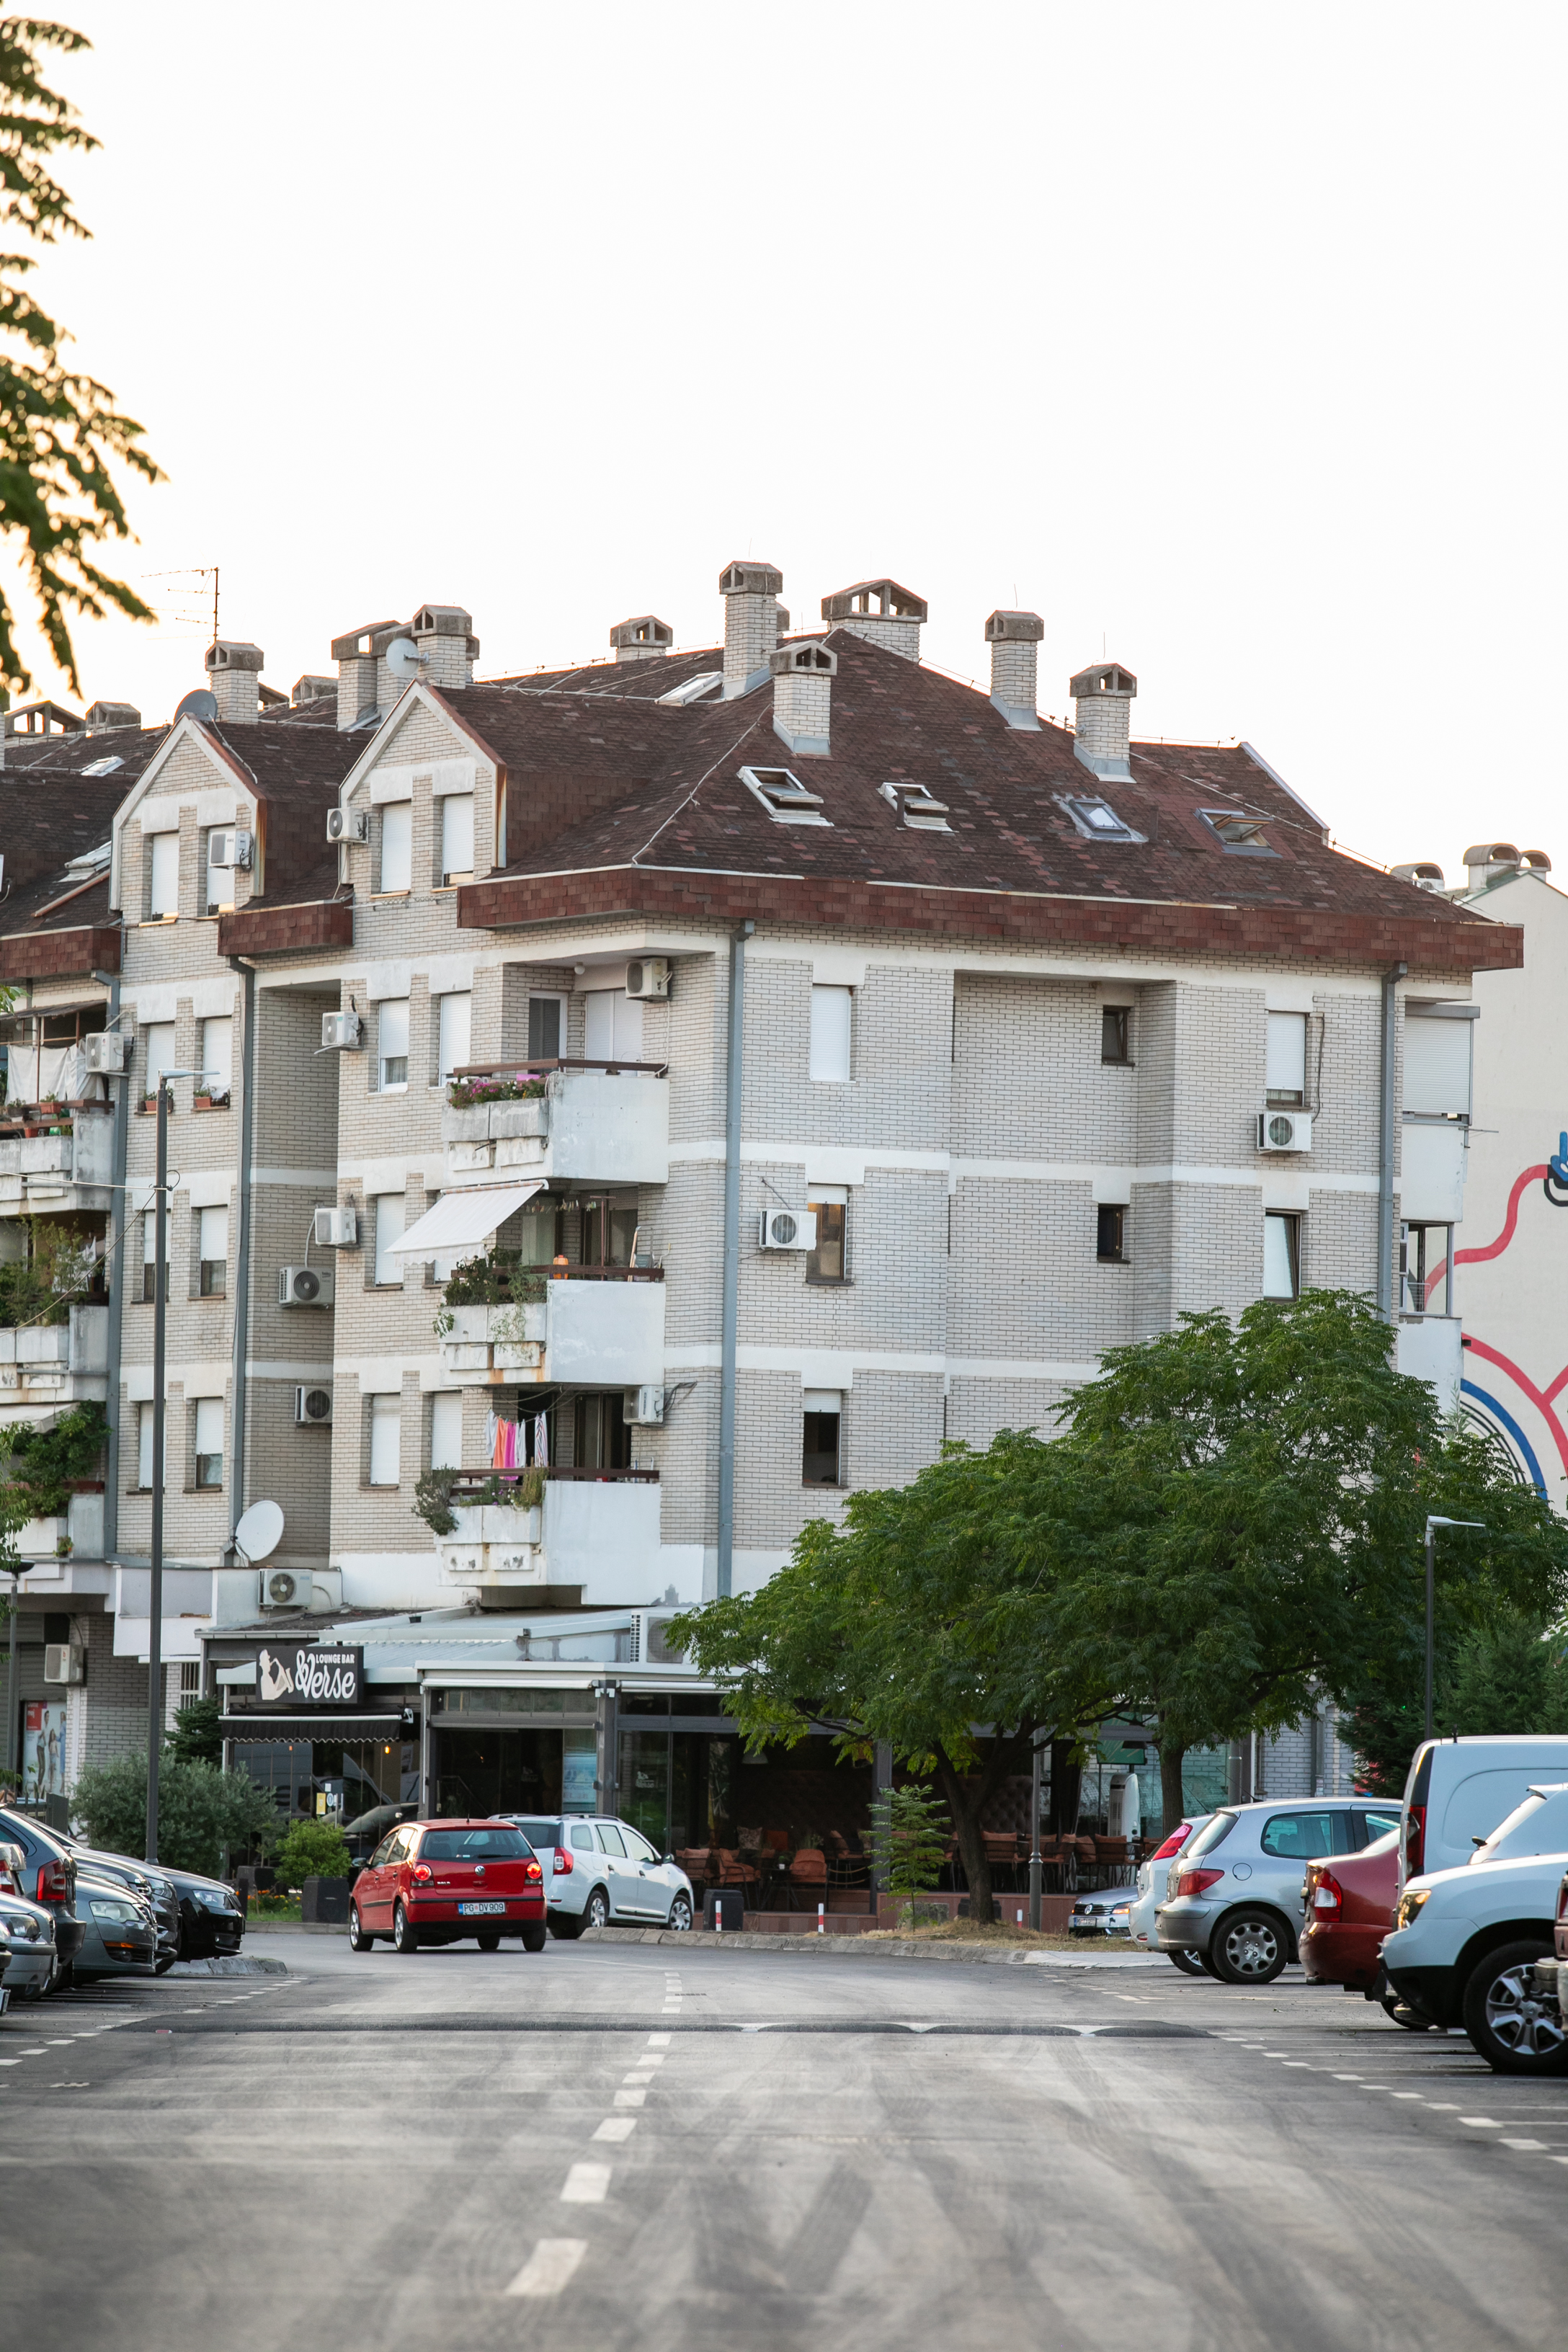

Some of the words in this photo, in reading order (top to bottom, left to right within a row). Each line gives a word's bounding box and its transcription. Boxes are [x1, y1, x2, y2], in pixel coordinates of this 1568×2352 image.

[316, 1654, 341, 1664] LOUNGE
[342, 1654, 355, 1664] BAR
[464, 1904, 474, 1912] PG
